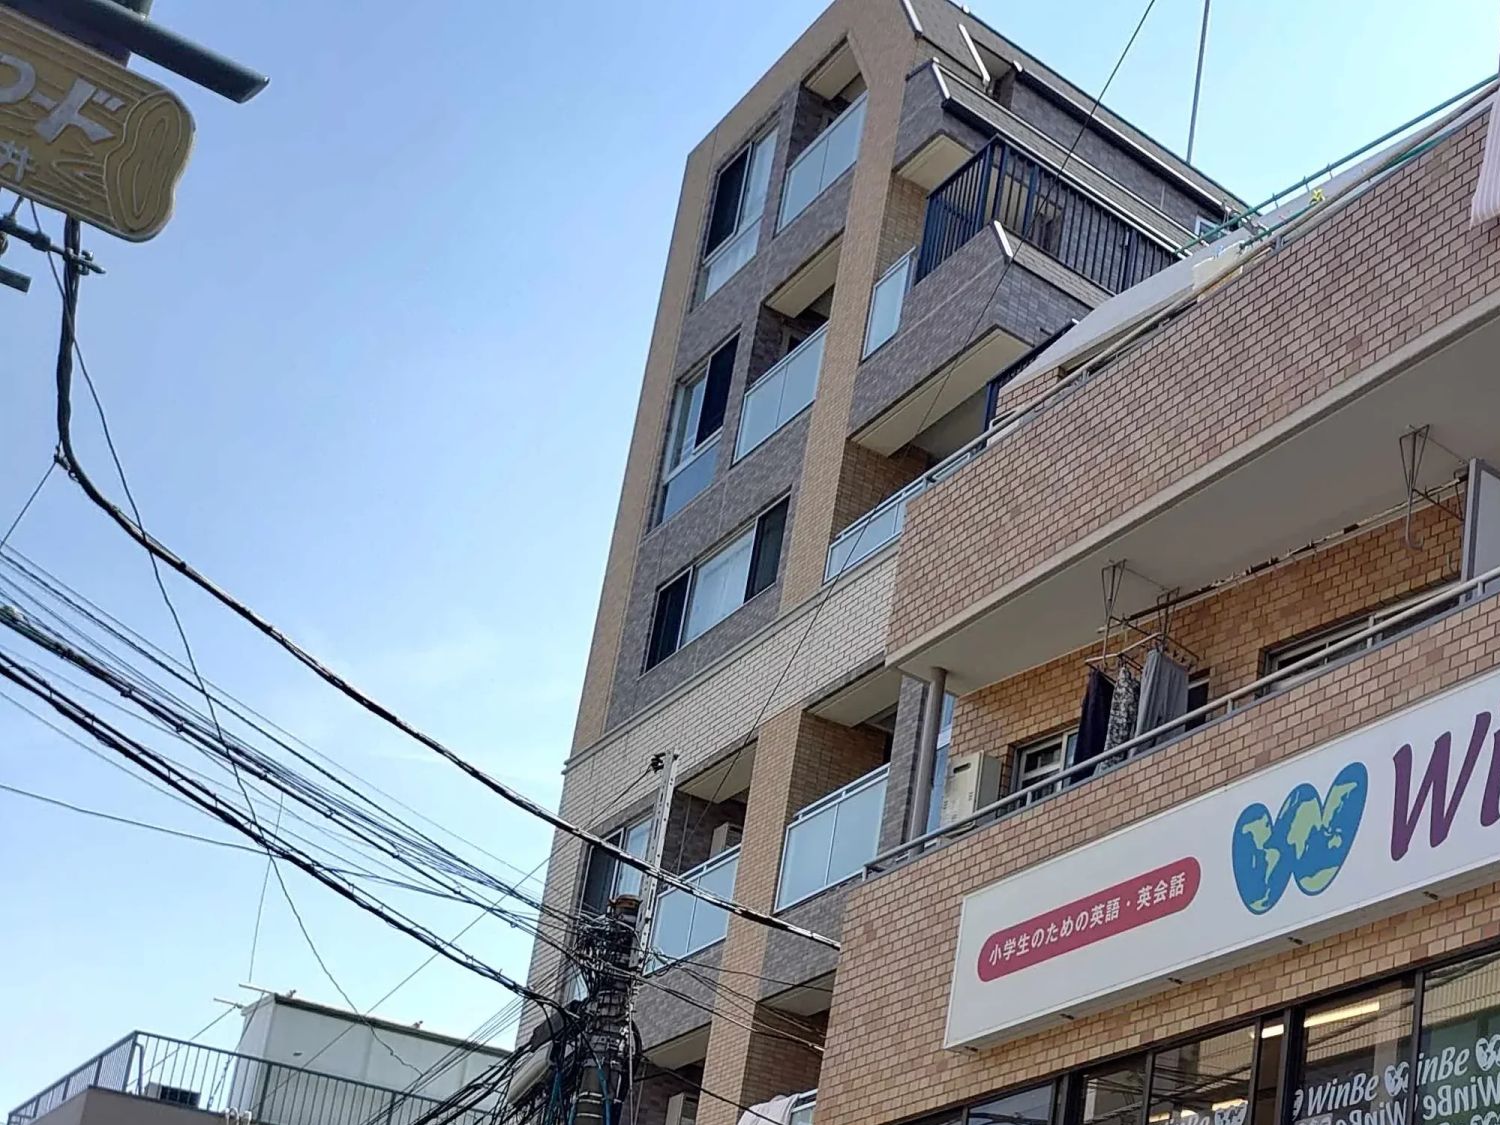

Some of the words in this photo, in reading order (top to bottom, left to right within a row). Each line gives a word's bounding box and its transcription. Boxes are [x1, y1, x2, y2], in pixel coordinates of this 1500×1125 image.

[988, 871, 1187, 967] 小学生のための英語・英会話
[1307, 1072, 1379, 1117] WinBe
